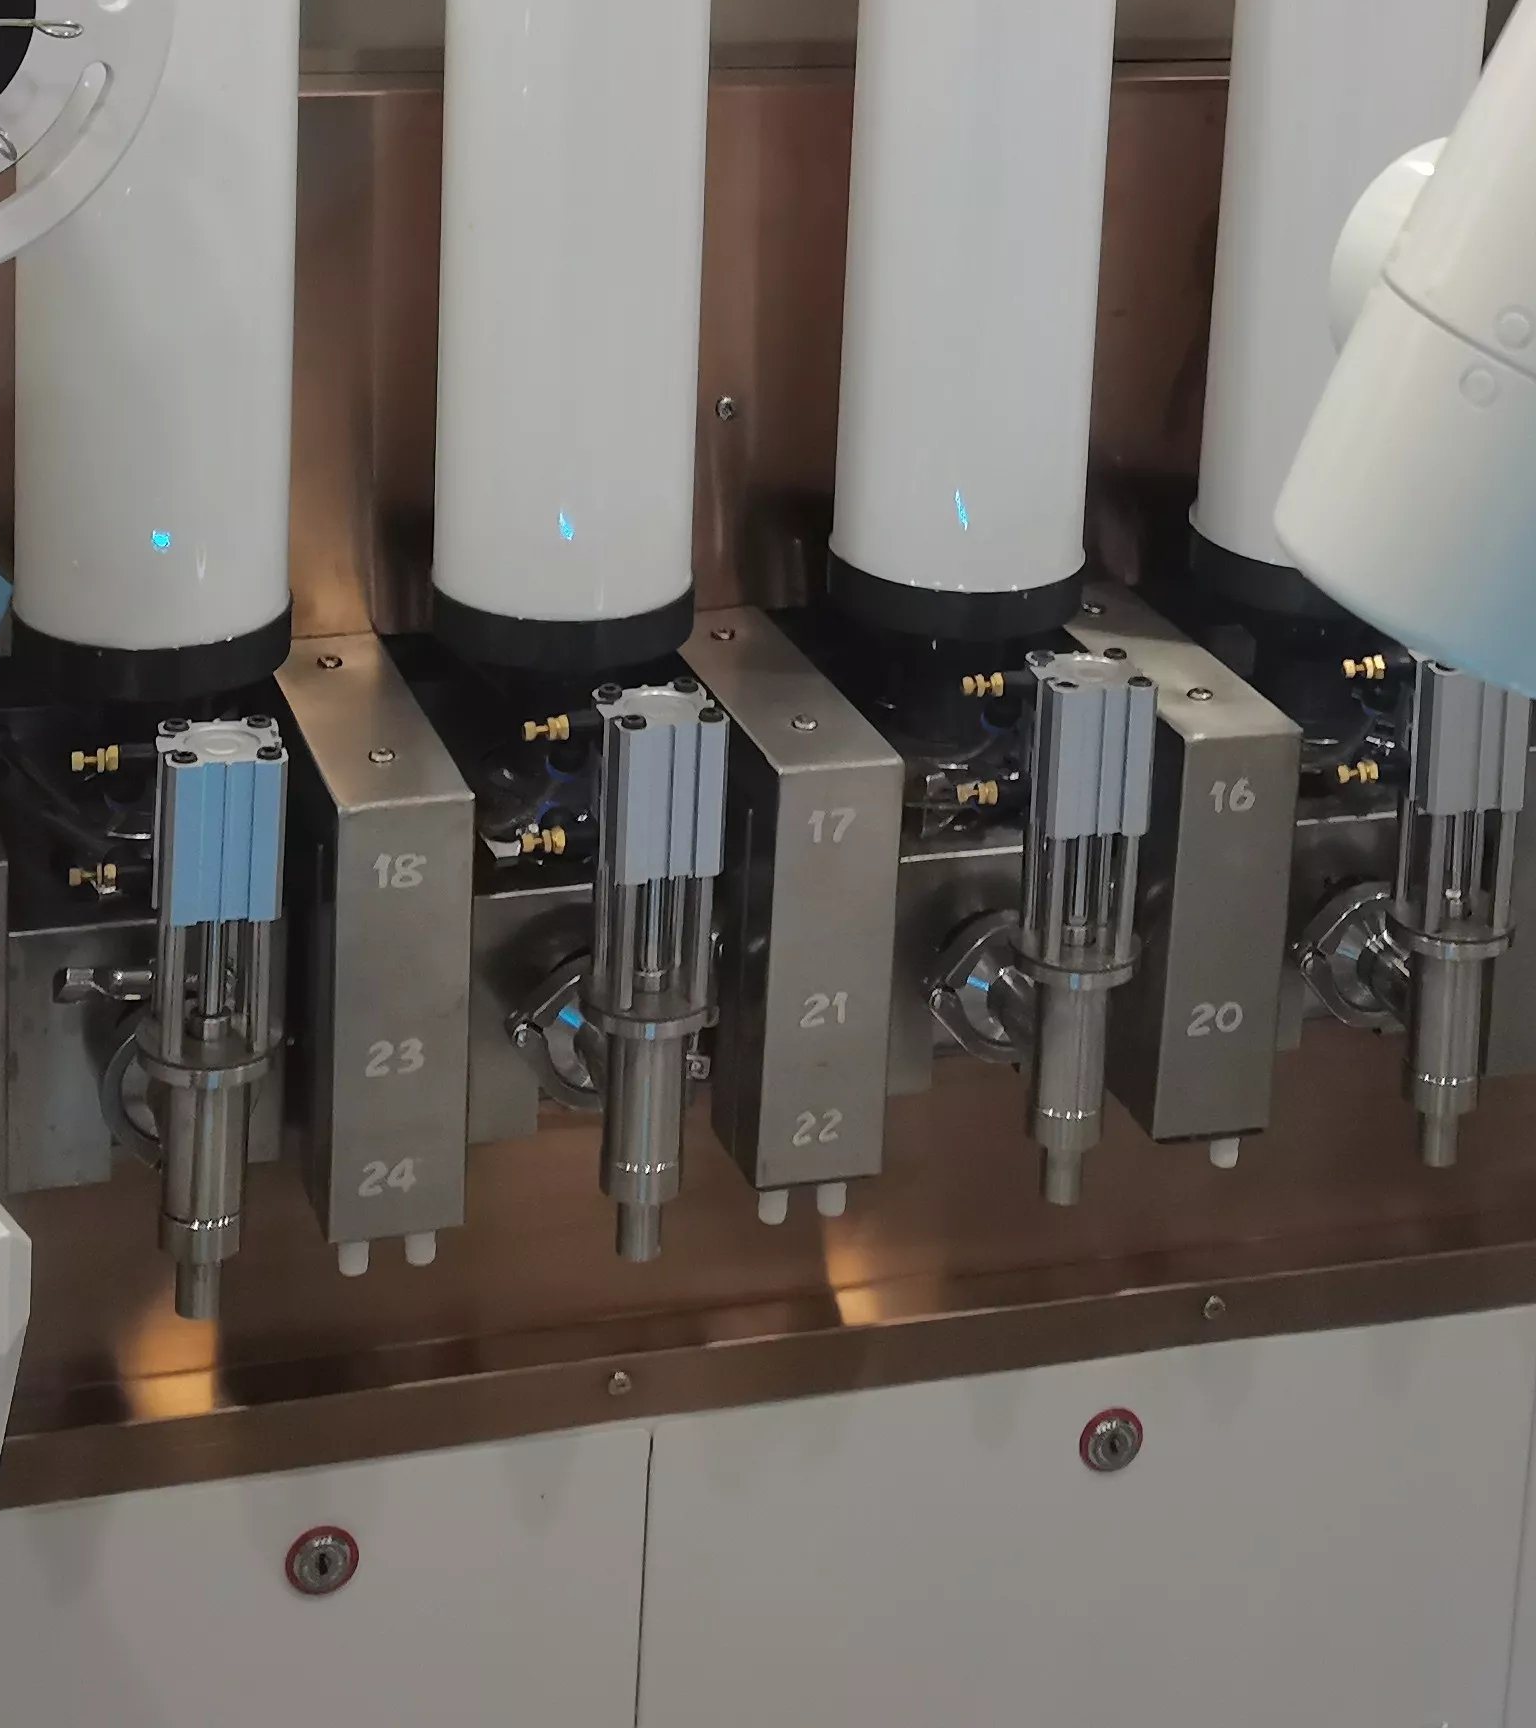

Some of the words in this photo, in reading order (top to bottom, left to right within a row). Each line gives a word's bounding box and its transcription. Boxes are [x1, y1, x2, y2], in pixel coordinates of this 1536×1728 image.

[1208, 780, 1256, 813] 16
[808, 809, 858, 844] 17
[373, 854, 425, 889] 18
[799, 992, 848, 1027] 21
[1186, 1001, 1245, 1037] 20
[364, 1041, 425, 1076] 23
[791, 1110, 845, 1145] 22
[357, 1161, 418, 1196] 24
